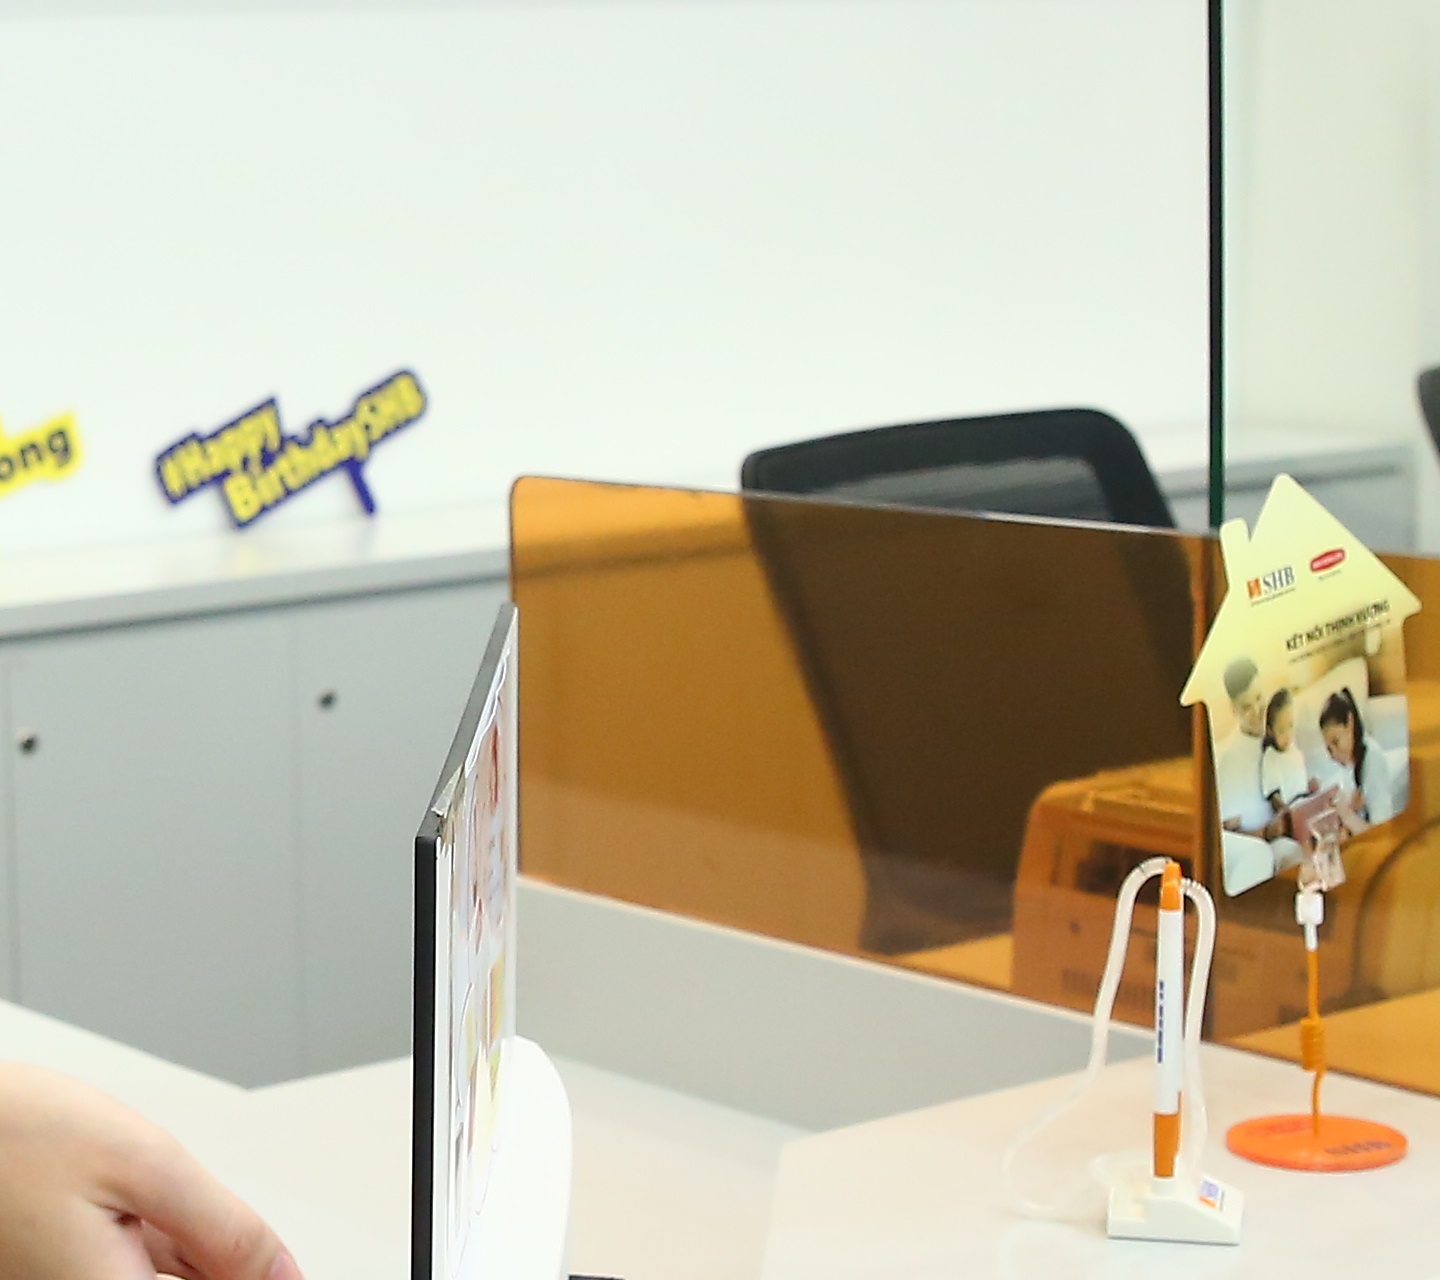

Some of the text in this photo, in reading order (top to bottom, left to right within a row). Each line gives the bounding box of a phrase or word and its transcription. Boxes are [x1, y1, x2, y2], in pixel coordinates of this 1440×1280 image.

[160, 407, 281, 498] #Happy
[223, 373, 424, 521] BirthdaySHB
[1262, 566, 1295, 594] SHB
